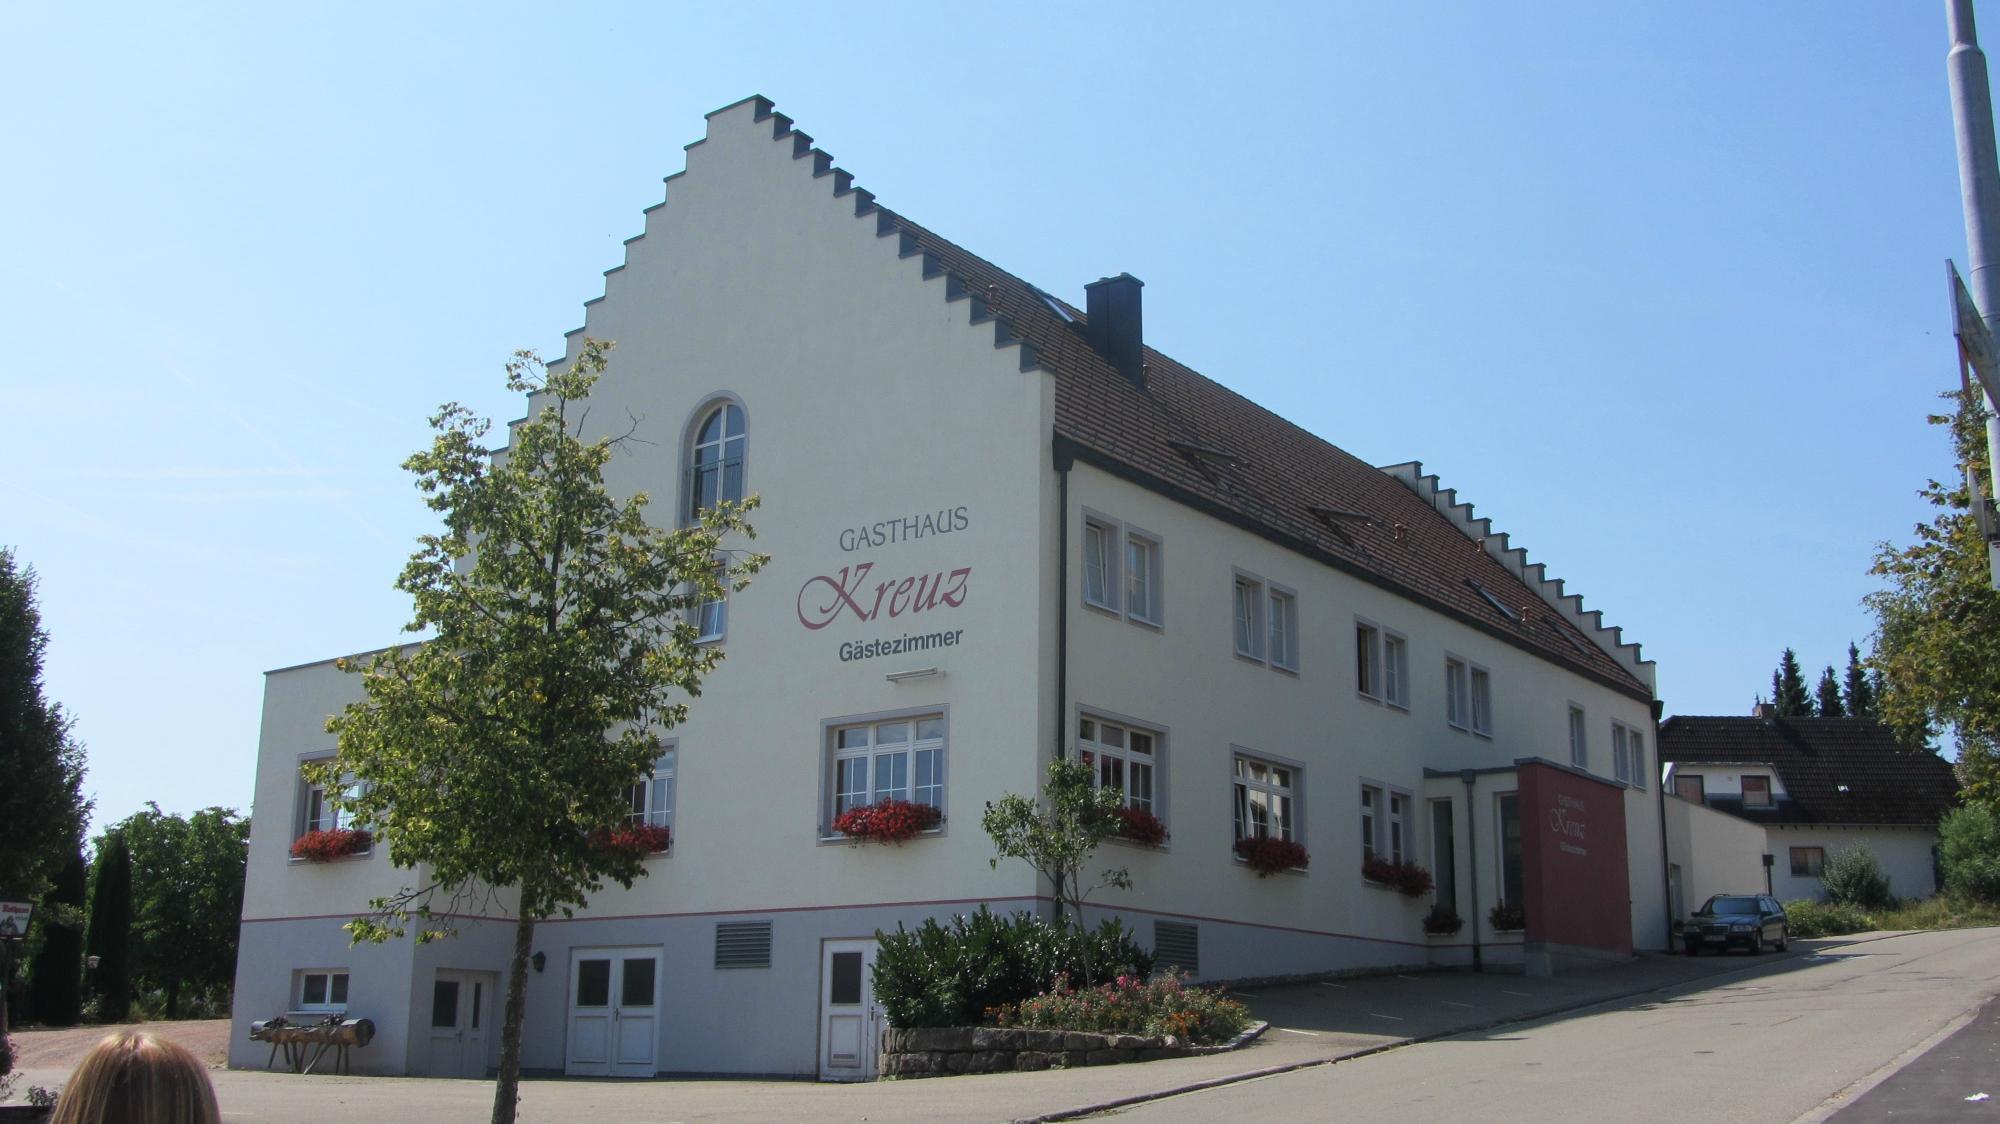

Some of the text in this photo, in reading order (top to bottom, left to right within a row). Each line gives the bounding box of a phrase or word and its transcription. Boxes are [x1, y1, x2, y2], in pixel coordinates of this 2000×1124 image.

[839, 506, 969, 552] GASTHAUS
[797, 562, 972, 630] Kreuz
[839, 629, 963, 662] Gästezimmer
